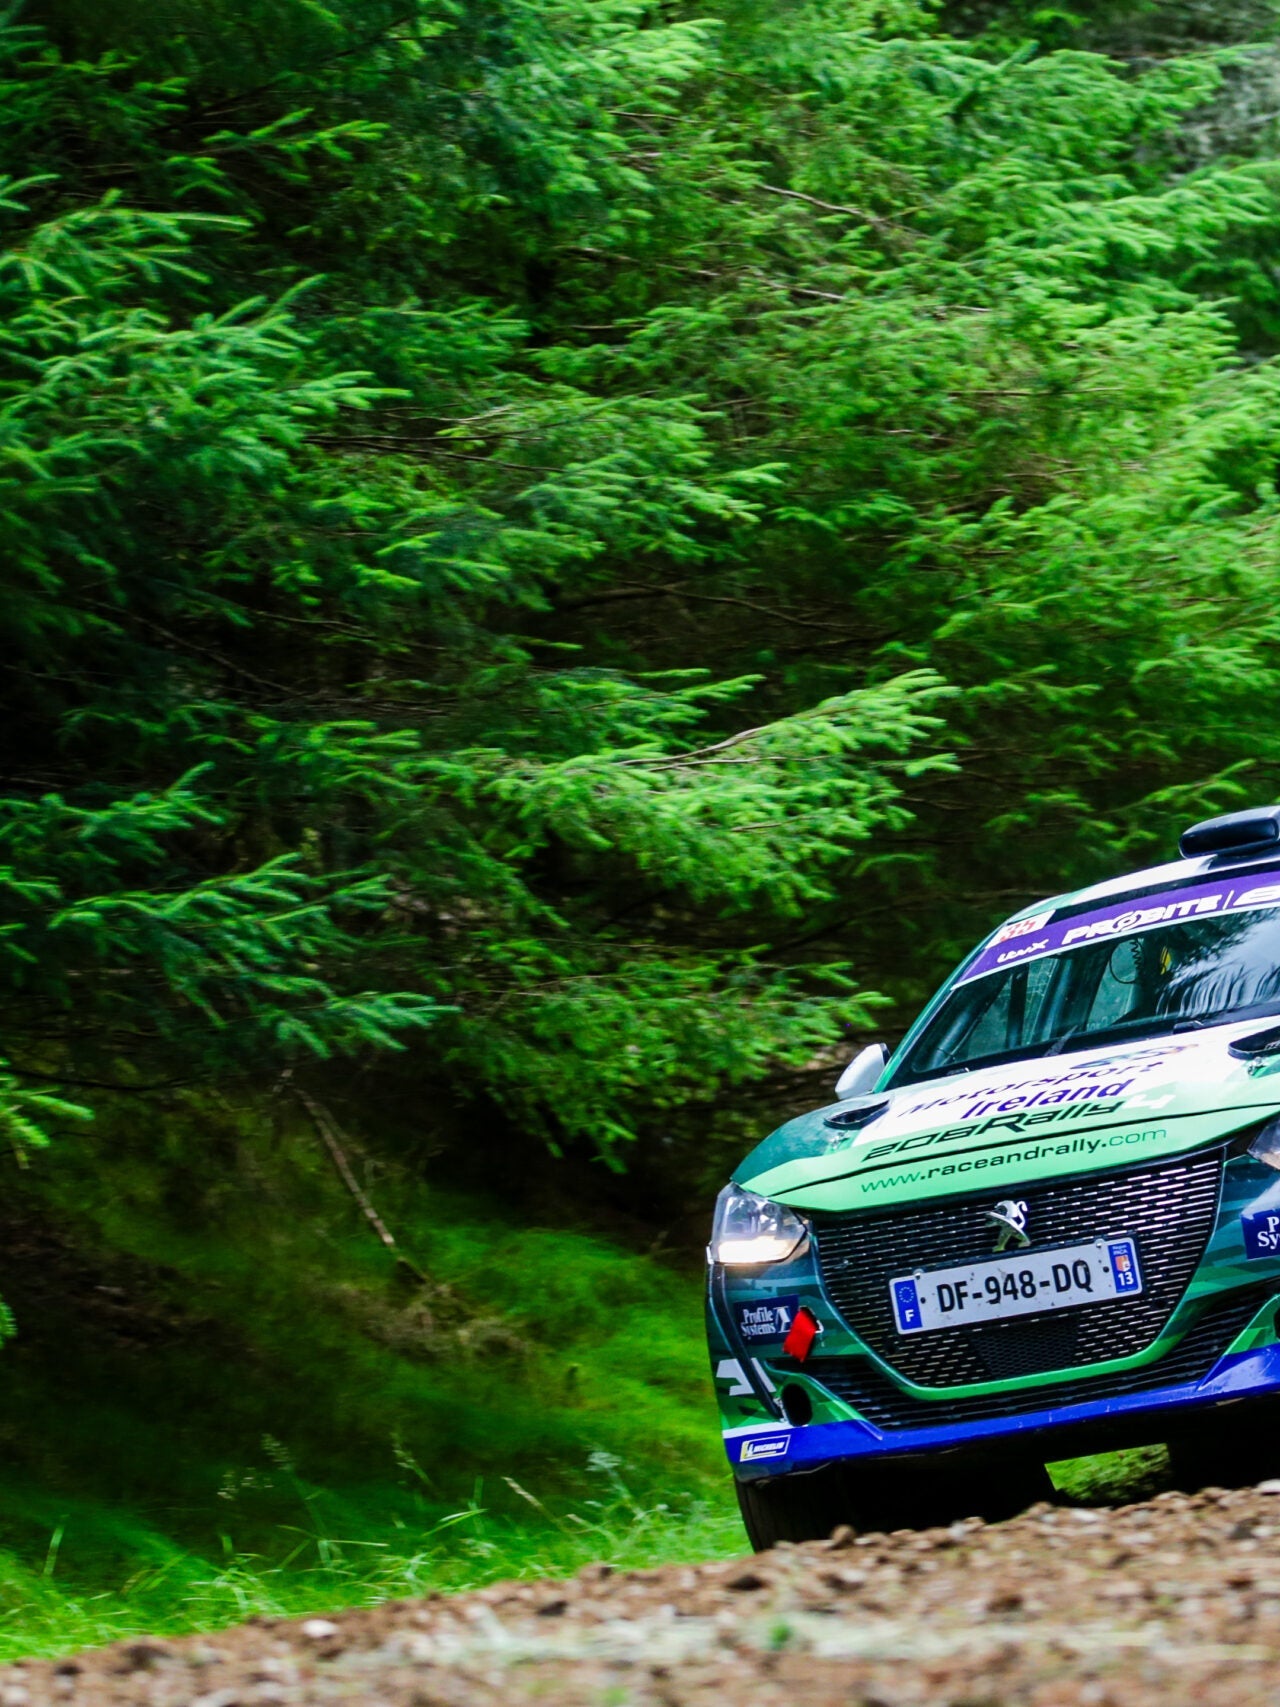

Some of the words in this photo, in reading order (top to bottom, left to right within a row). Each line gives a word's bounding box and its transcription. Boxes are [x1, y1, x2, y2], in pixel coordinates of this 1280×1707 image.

[1061, 895, 1223, 945] PROBITE
[897, 1061, 1164, 1118] Motorsport
[961, 1078, 1136, 1120] Ireland
[861, 1129, 1167, 1193] www.raceandrally.com
[936, 1259, 1094, 1313] DF-948-DQ
[1117, 1271, 1134, 1287] 13
[740, 1322, 777, 1339] Systems
[742, 1306, 774, 1324] Profile
[904, 1309, 914, 1323] F
